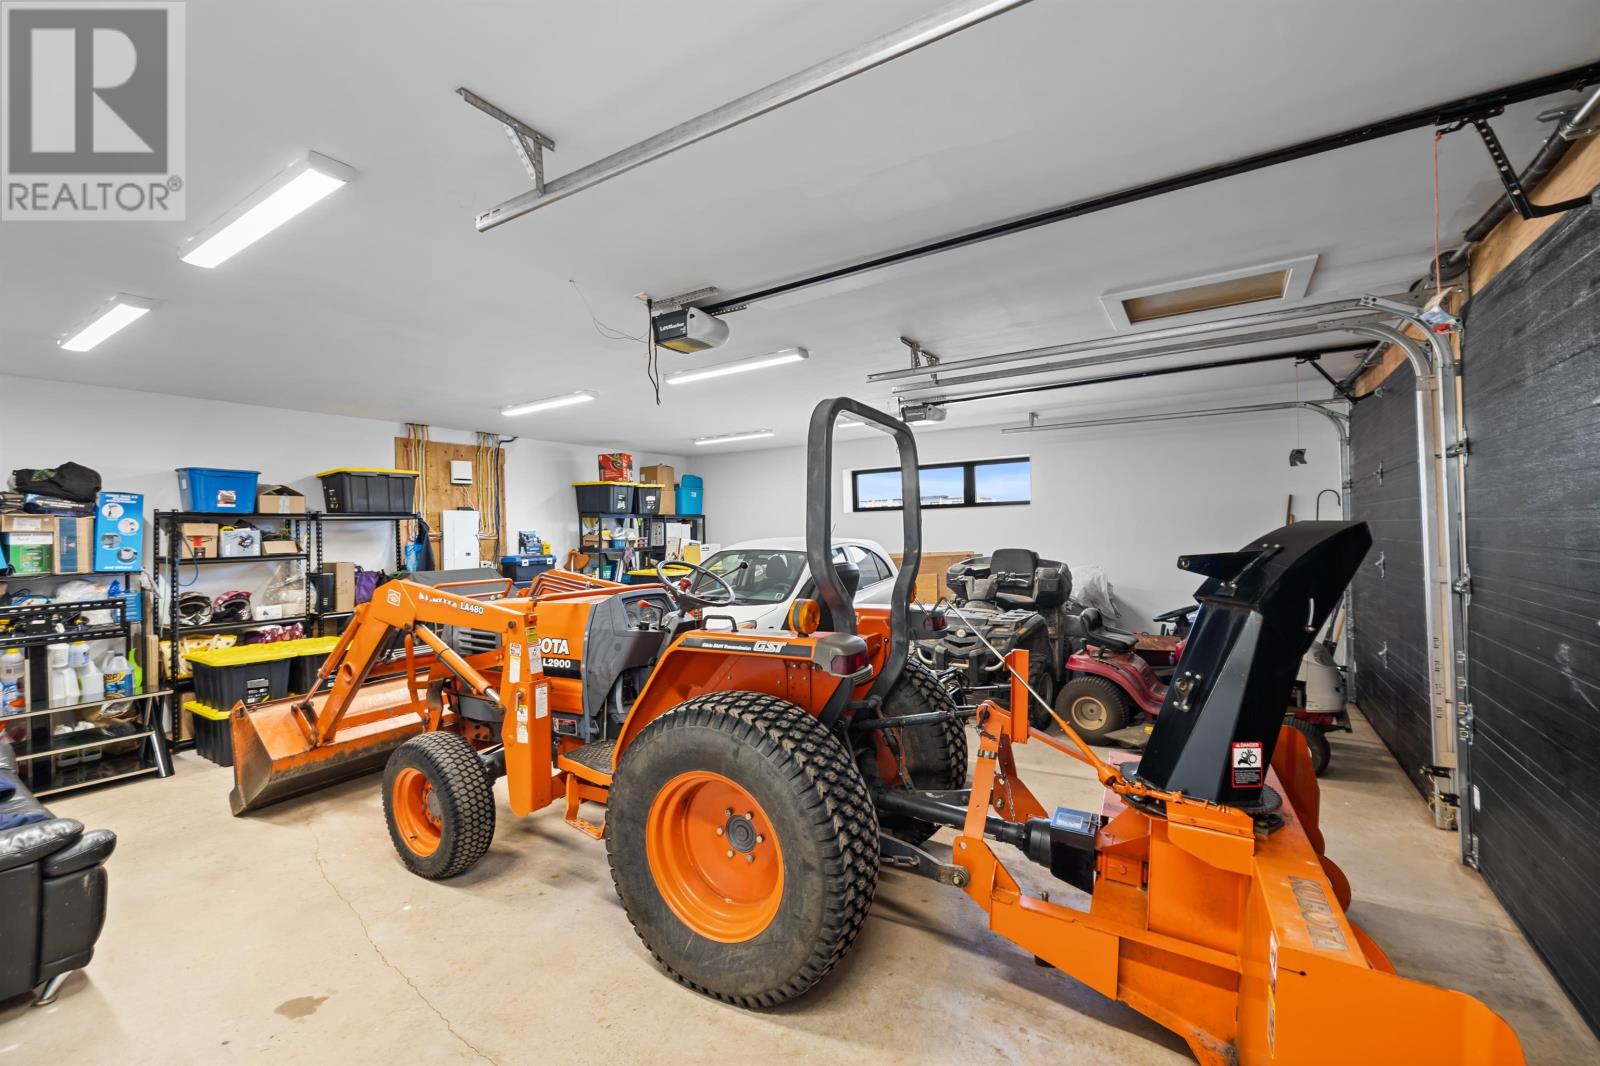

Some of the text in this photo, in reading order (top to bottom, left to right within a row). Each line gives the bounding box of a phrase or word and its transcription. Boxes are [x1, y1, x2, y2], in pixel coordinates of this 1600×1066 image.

[460, 601, 484, 616] LA480
[753, 640, 787, 653] GST
[542, 657, 571, 669] L2900
[1287, 873, 1348, 952] KUBOTA
